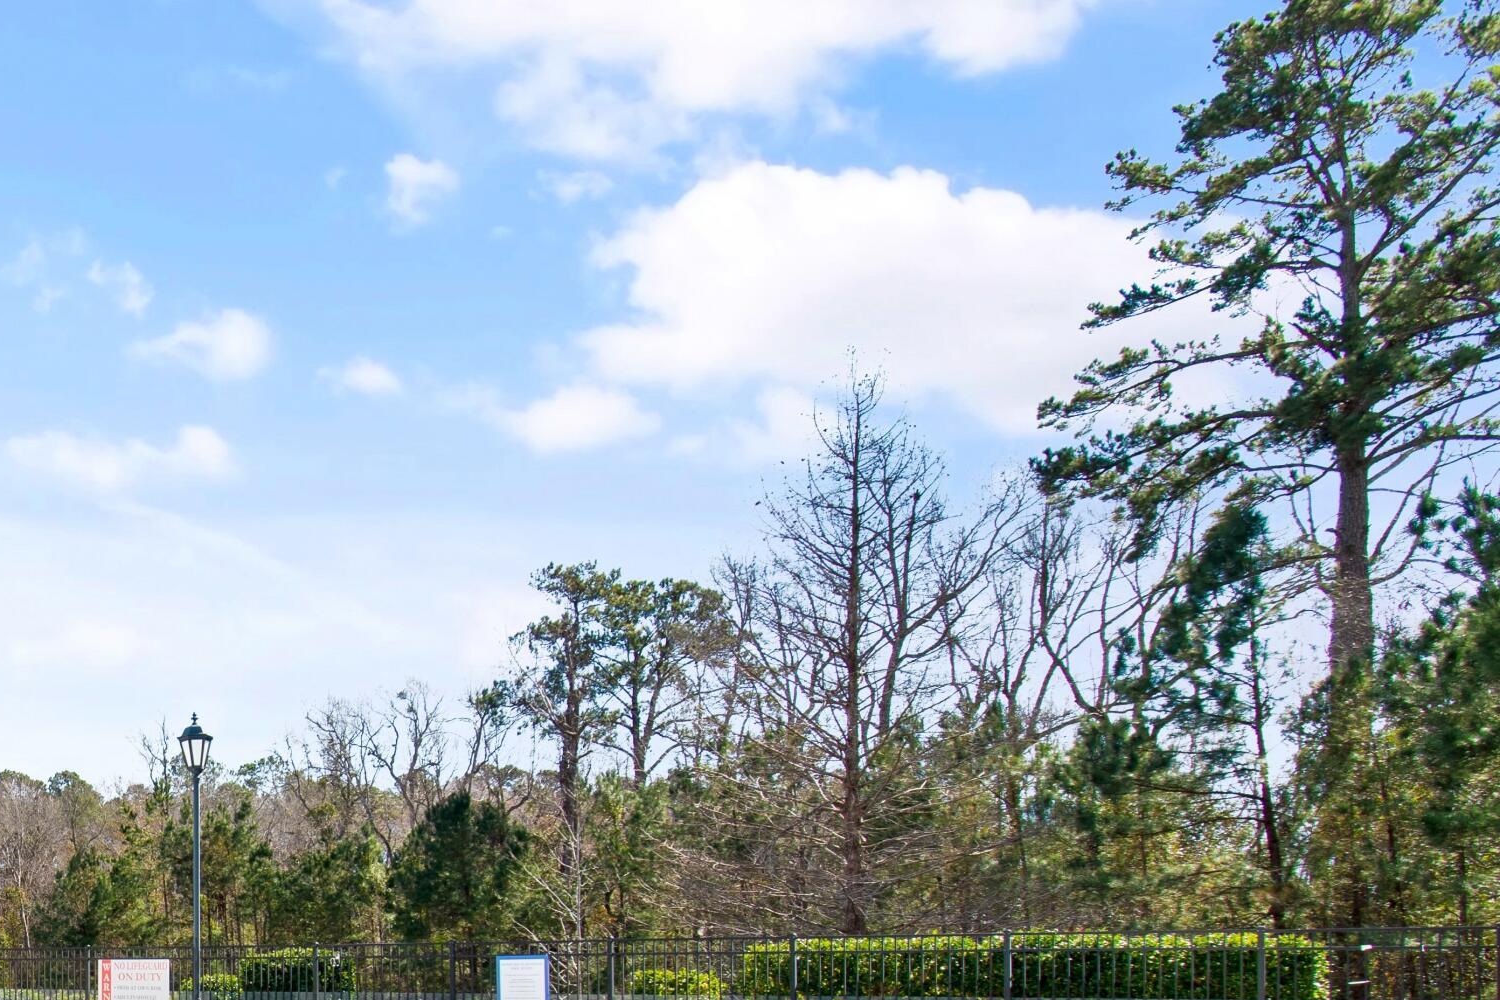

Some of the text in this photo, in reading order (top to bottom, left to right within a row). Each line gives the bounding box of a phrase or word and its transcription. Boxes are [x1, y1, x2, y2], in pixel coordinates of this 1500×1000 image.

[113, 962, 168, 970] NO LIFEGUARD
[118, 972, 163, 981] ON DUTY
